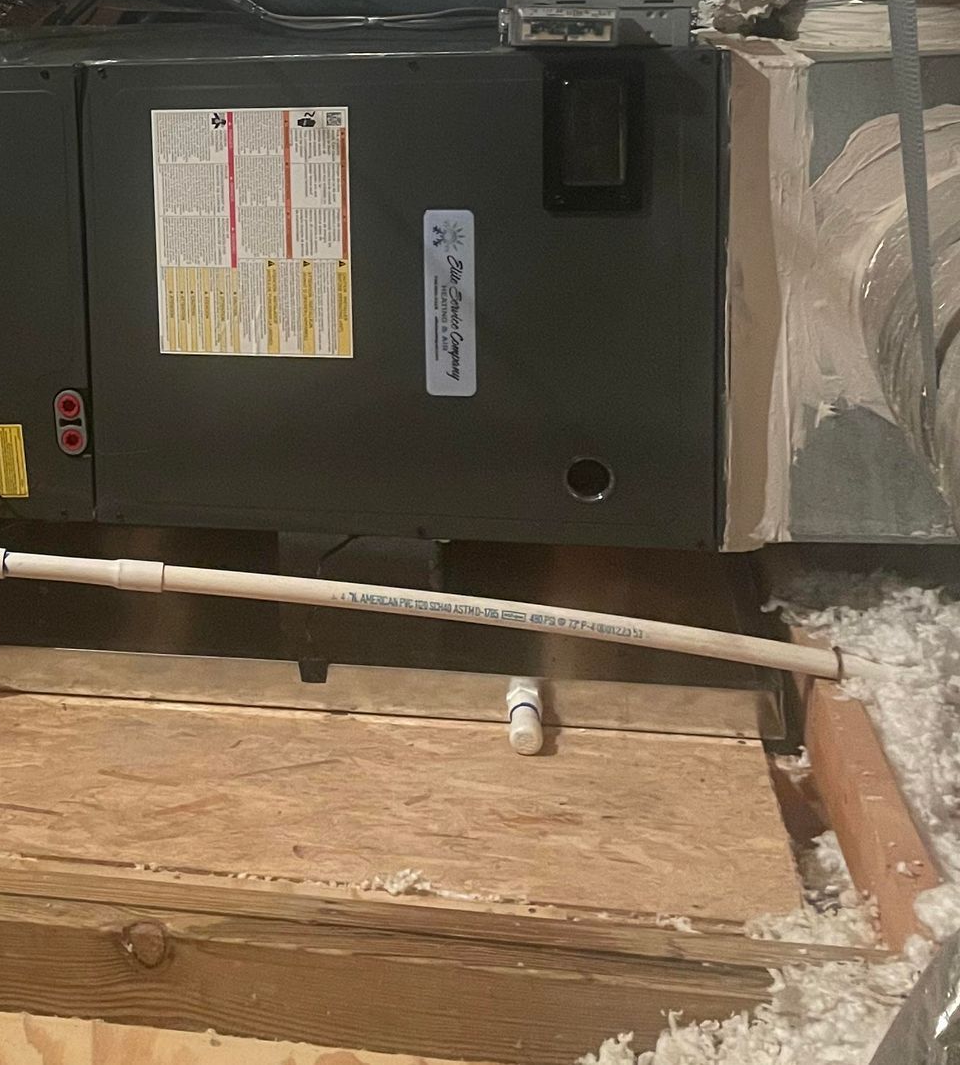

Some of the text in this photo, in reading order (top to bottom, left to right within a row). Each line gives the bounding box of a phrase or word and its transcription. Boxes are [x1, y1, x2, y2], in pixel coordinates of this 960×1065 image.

[447, 256, 464, 381] Elite Service Company
[360, 593, 398, 607] AMERICAN
